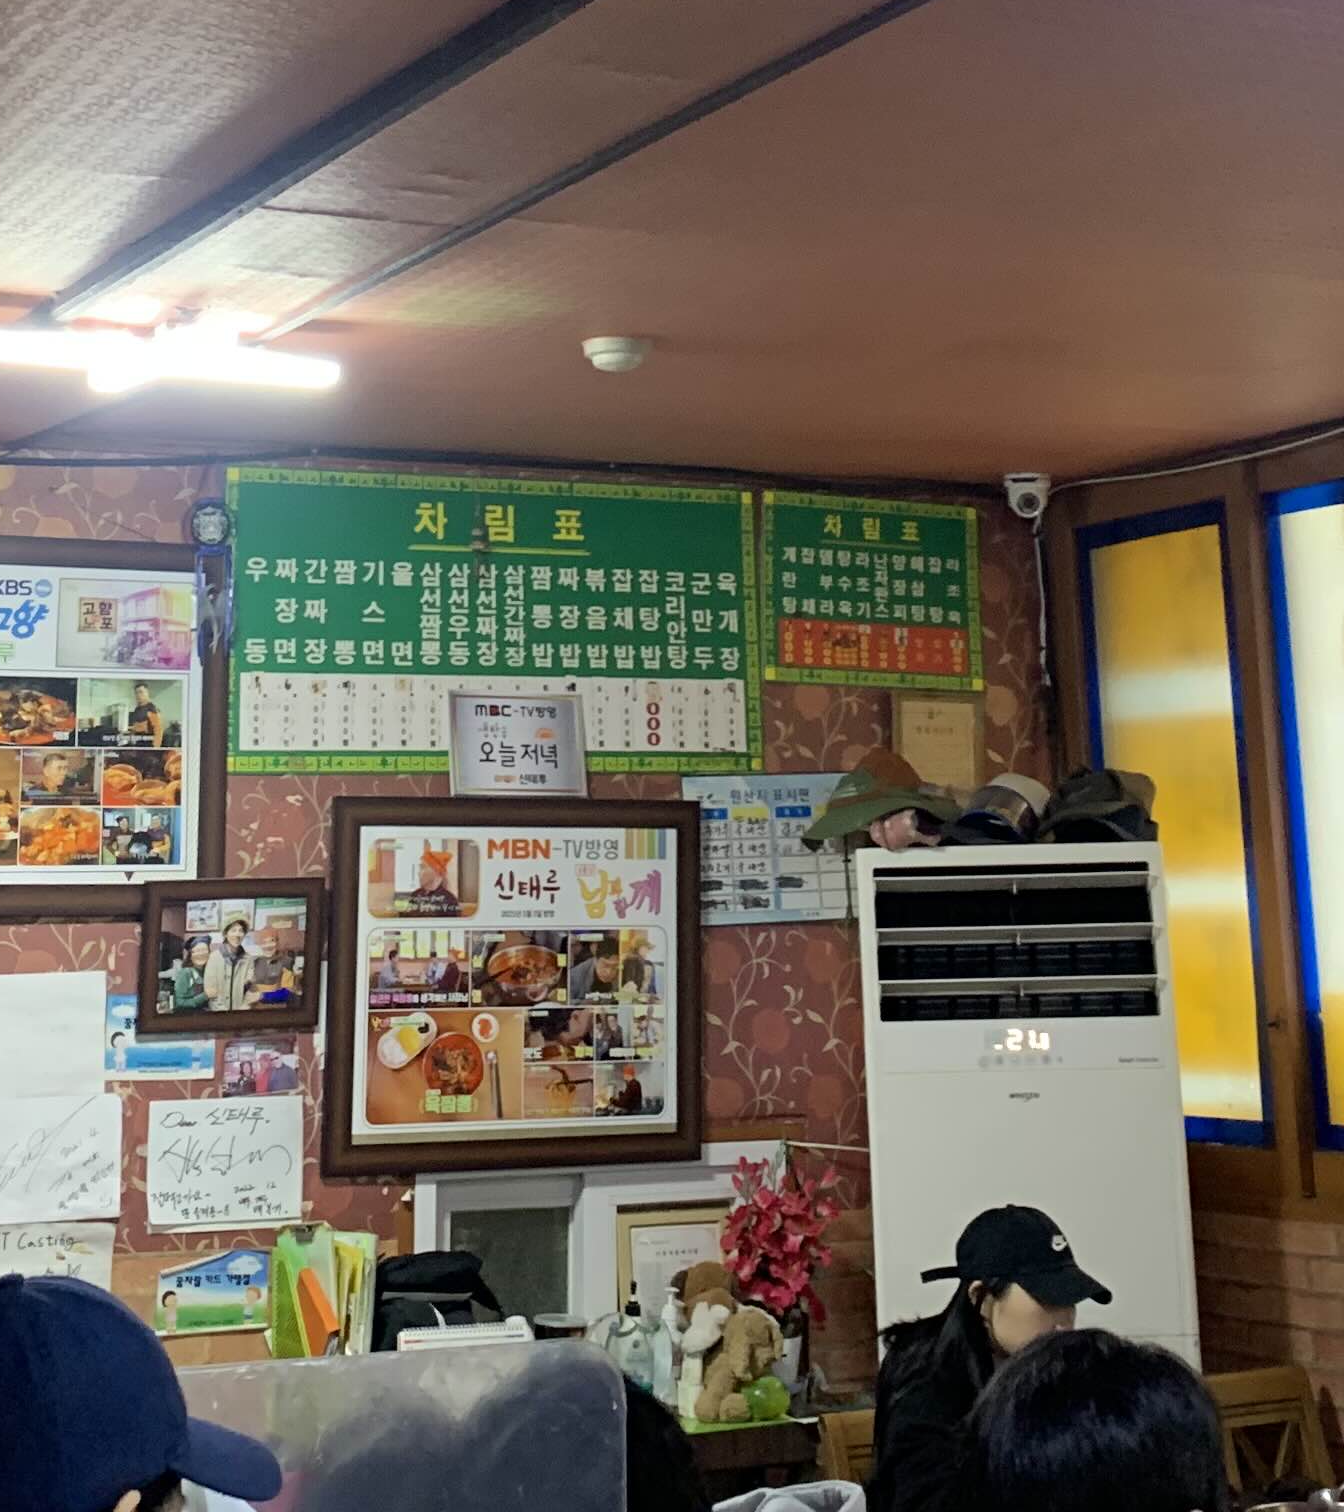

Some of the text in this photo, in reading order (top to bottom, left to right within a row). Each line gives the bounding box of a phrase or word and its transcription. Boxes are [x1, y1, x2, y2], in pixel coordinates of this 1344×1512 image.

[414, 502, 584, 543] 차림표
[823, 514, 920, 542] 차림표
[244, 556, 268, 664] 우동
[273, 558, 298, 663] 짜장면
[303, 558, 328, 664] 간짜장
[332, 559, 357, 665] 짬뽕
[361, 560, 385, 665] 기스면
[419, 562, 443, 665] 삼선짬뽕
[447, 563, 470, 666] 삼선우동
[476, 564, 498, 667] 삼선짜장
[503, 564, 527, 667] 삼선간짜장
[558, 567, 582, 669] 짜장밥
[584, 568, 608, 669] 볶음밥
[612, 568, 635, 670] 잡채밥
[638, 569, 662, 670] 잡탕밥
[664, 571, 688, 670] 코리안탕
[690, 572, 714, 671] 군만두
[717, 572, 740, 672] 육개장
[494, 869, 561, 904] 신태루
